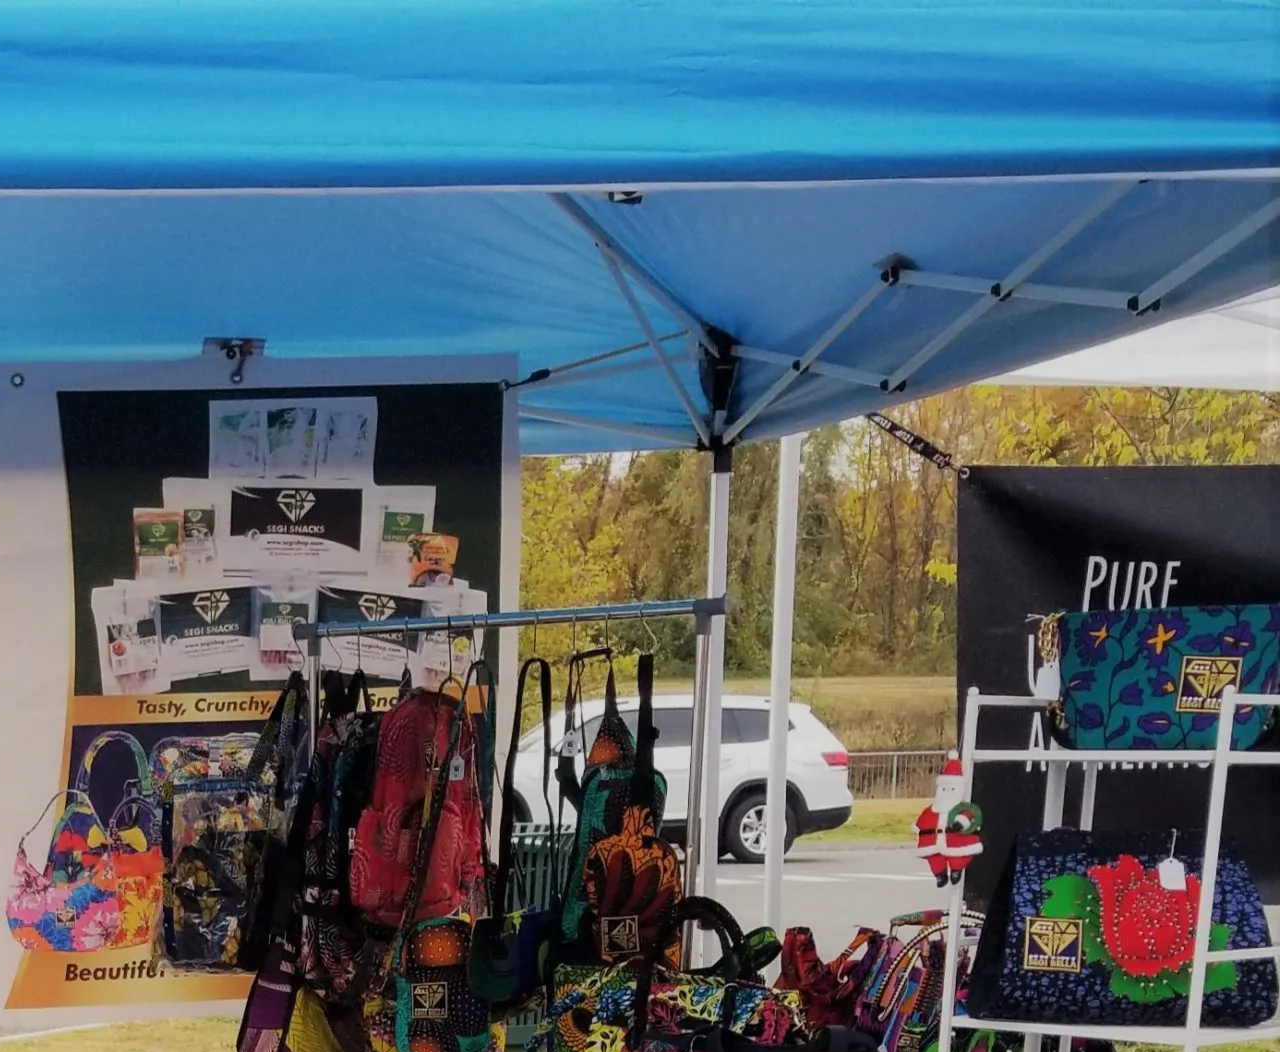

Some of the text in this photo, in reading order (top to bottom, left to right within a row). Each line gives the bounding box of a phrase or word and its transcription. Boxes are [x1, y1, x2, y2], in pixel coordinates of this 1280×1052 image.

[184, 627, 204, 637] SEGI
[136, 699, 187, 717] Tasty,
[194, 696, 275, 716] Crunchy,
[65, 960, 165, 982] Beautifu
